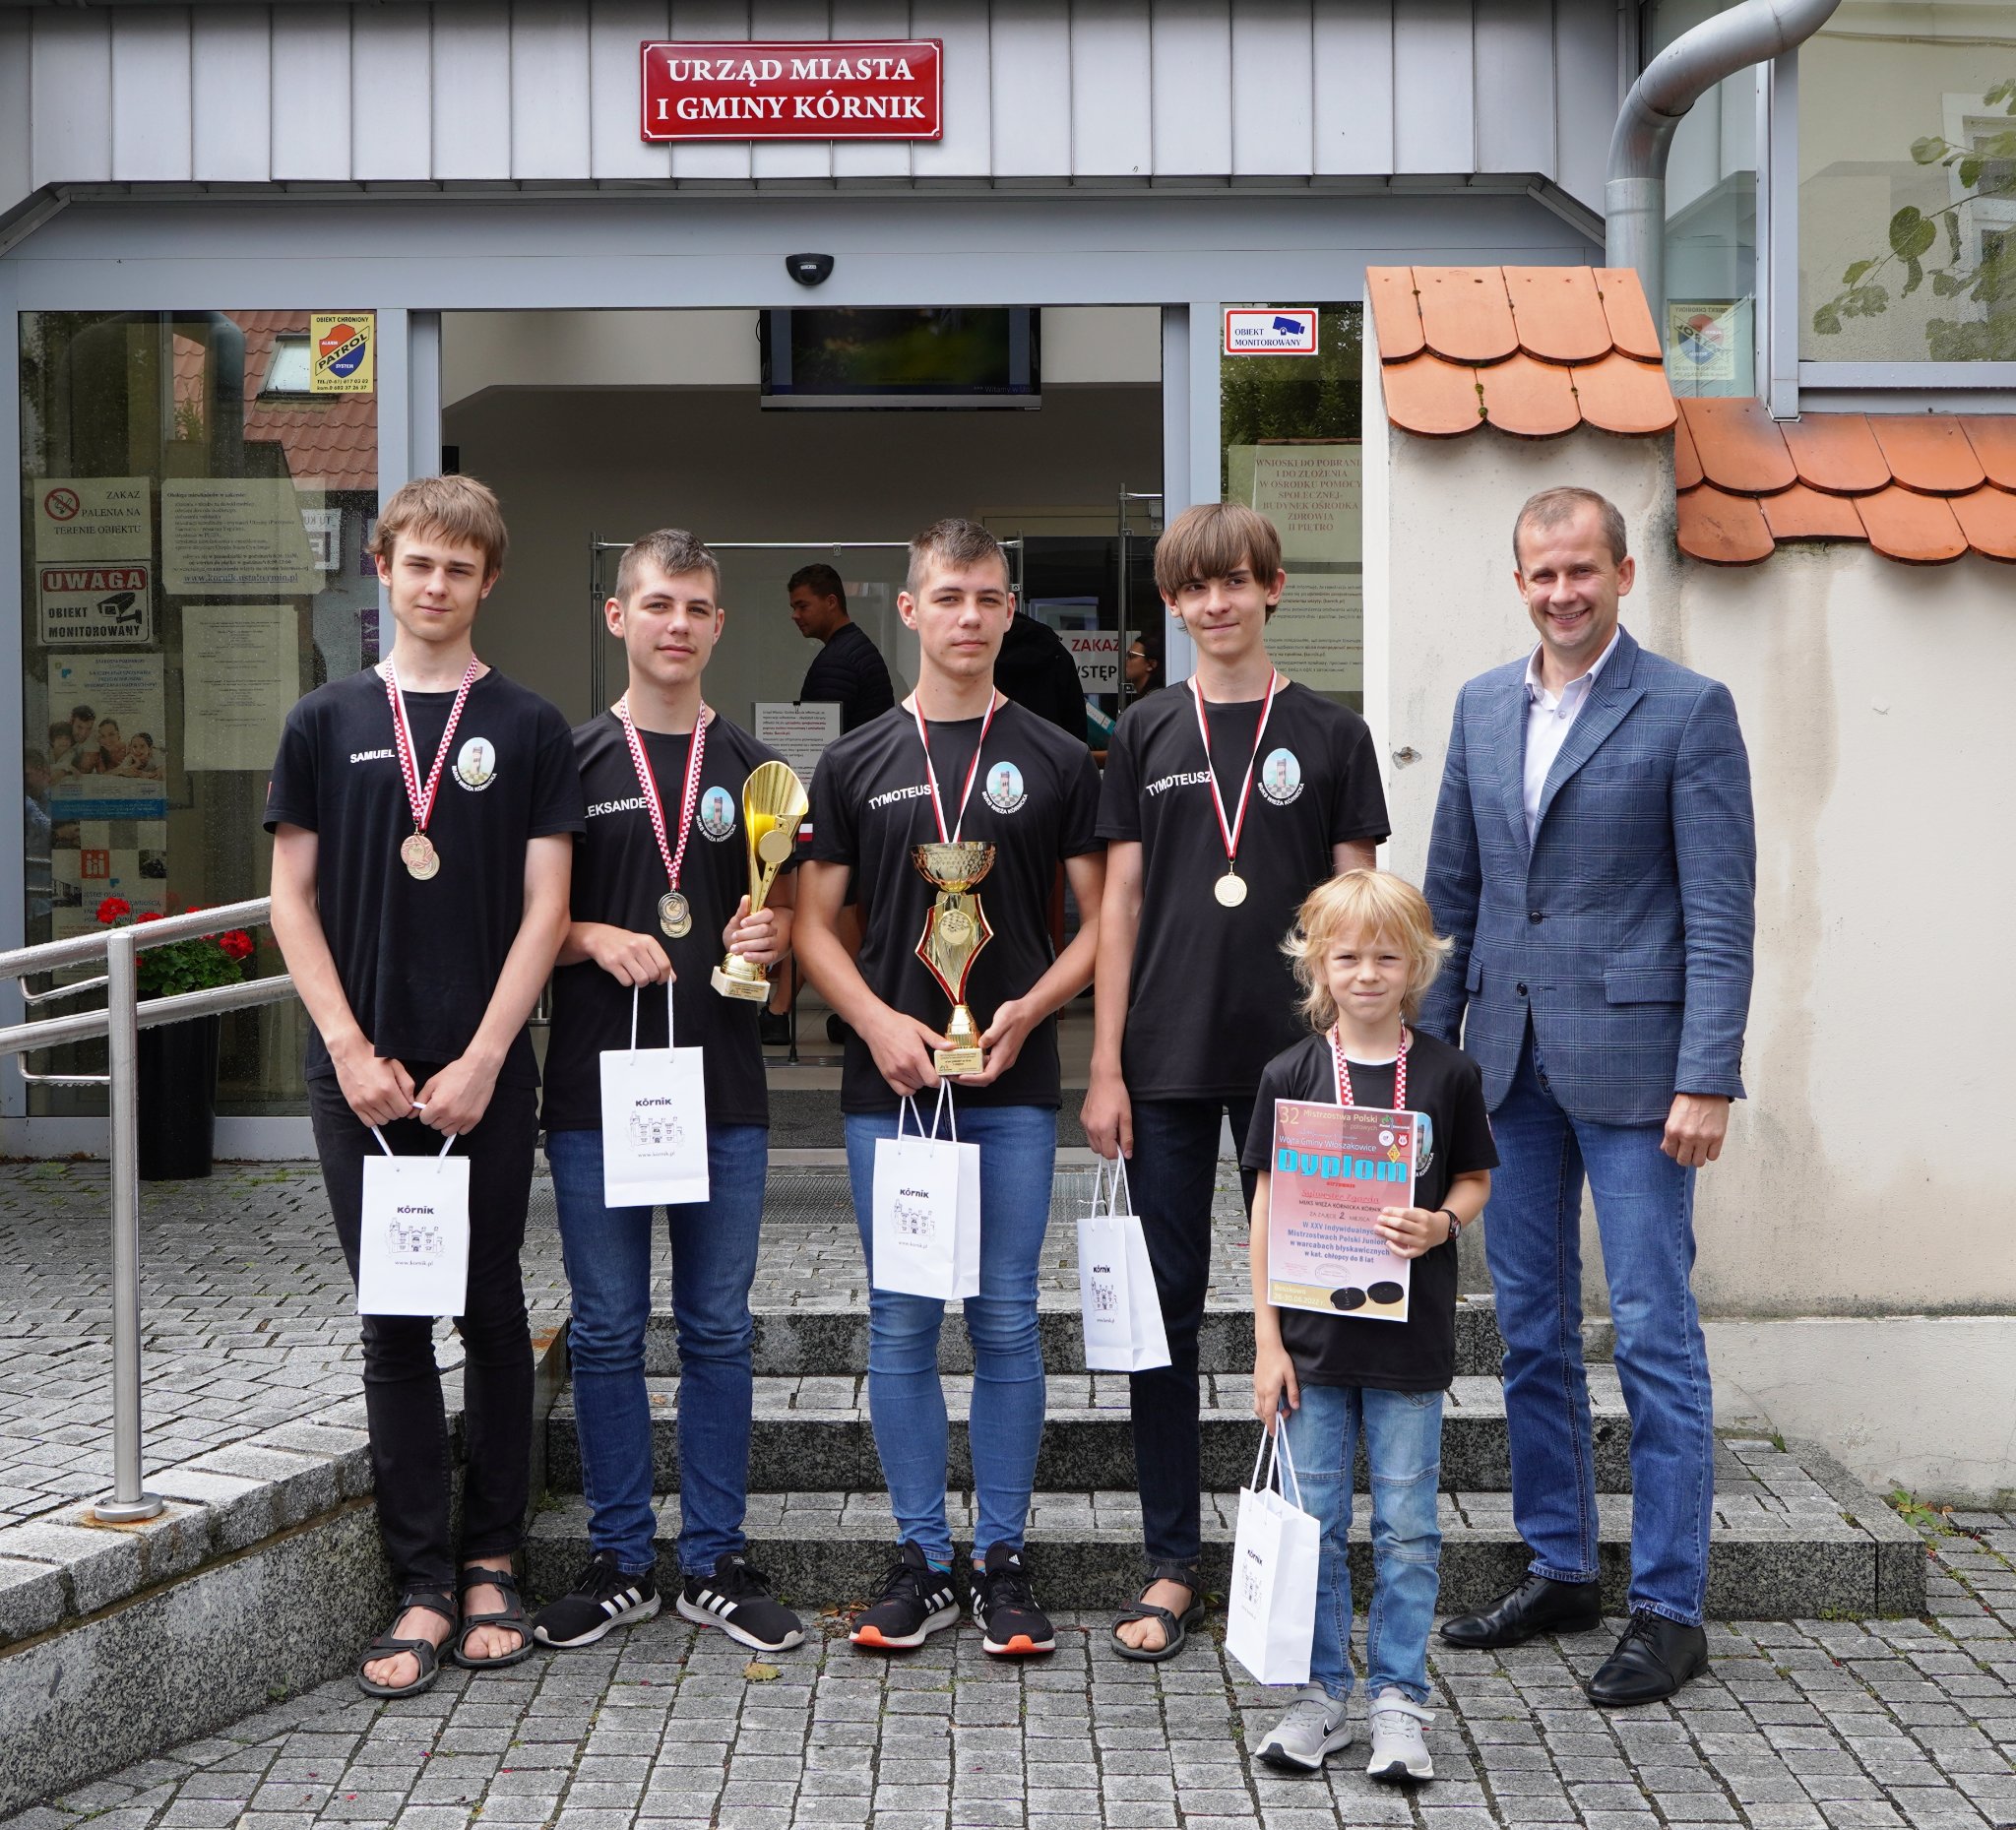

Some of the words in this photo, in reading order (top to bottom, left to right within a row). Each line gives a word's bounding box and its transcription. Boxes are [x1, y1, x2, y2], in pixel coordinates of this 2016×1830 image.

[667, 59, 783, 87] URZĄD
[789, 58, 914, 81] MIASTA
[657, 97, 669, 120] I
[676, 96, 788, 120] GMINY
[793, 89, 925, 119] KÓRNIK
[318, 333, 368, 369] PATROL
[1317, 458, 1361, 467] POBRANI
[106, 491, 141, 500] ZAKAZ
[81, 508, 124, 517] PALENIA
[126, 508, 141, 517] NA
[54, 526, 95, 535] TERENIE
[98, 525, 141, 534] OBIEKTU
[47, 571, 142, 590] UWAGA
[49, 607, 87, 618] OBIEKT
[49, 625, 140, 638] MONITOROWANY
[1077, 665, 1117, 681] STĘP
[350, 749, 395, 763] SAMUEL
[1146, 770, 1211, 796] TYMOTEUSZ
[585, 797, 648, 818] EKSANDE
[1279, 1106, 1299, 1125] 32
[1303, 1109, 1351, 1121] Mistrzostwa
[1353, 1114, 1378, 1123] Polski
[1300, 1137, 1323, 1148] Gminy
[1324, 1139, 1377, 1152] Włoszakowice
[1278, 1148, 1408, 1183] Dyplom
[1288, 1230, 1337, 1241] Mistrzostwach
[1339, 1234, 1360, 1243] Polski
[1297, 1241, 1334, 1251] warcabach
[1335, 1244, 1390, 1256] błyskawicznych
[1324, 1252, 1349, 1262] chłopcy
